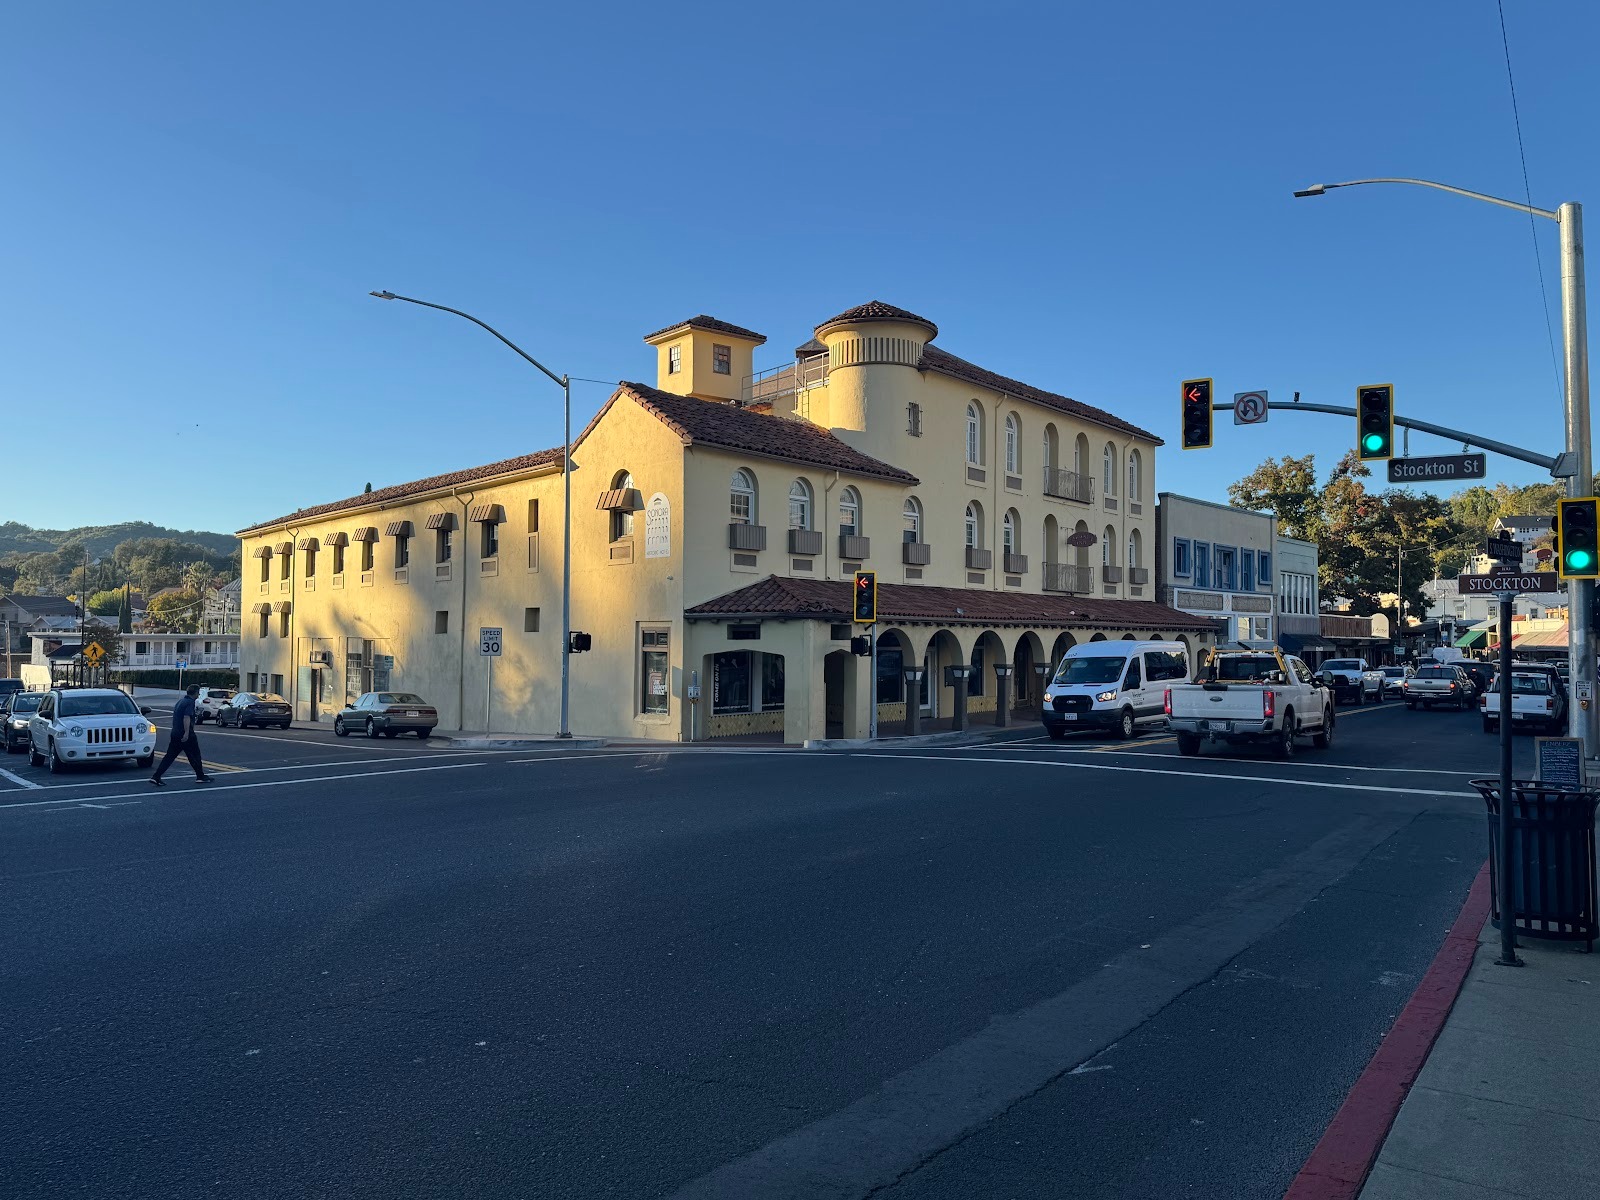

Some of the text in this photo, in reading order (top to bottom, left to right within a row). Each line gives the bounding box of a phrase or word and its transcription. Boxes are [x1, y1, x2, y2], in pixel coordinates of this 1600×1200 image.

[1394, 459, 1479, 477] Stockton St
[1469, 576, 1541, 591] STOCKTON
[482, 642, 500, 653] 30
